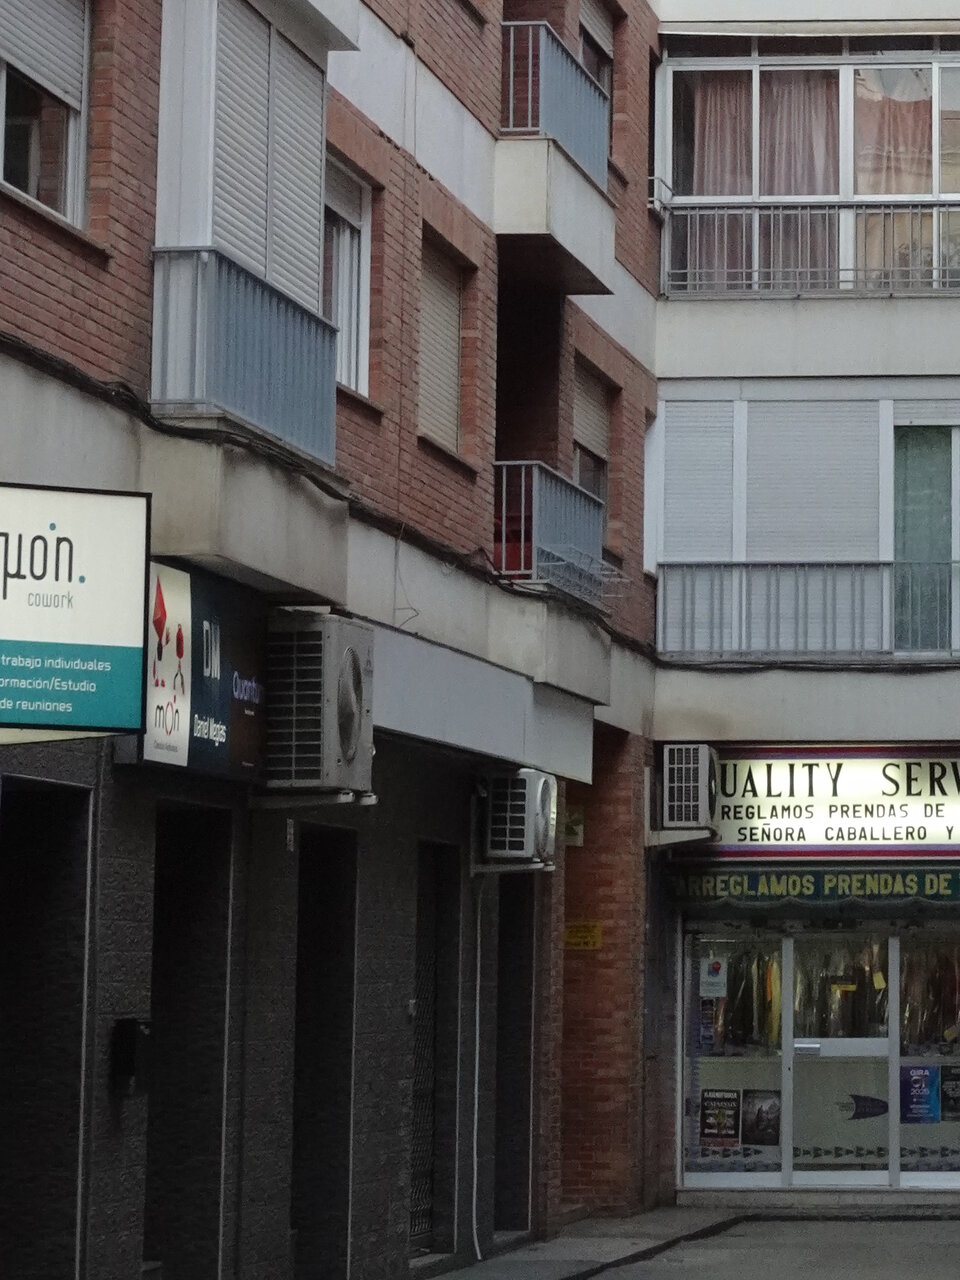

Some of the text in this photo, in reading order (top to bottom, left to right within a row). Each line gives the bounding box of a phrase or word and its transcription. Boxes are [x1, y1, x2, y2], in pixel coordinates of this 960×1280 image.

[27, 590, 74, 609] cowork
[1, 655, 111, 671] trabajo individuales
[0, 677, 97, 692] ormación/Estudio
[0, 699, 73, 712] de reuniones
[718, 761, 844, 799] UALITY
[721, 804, 815, 820] REGLAMOS
[829, 803, 909, 819] PRENDAS
[924, 803, 945, 818] DE
[737, 822, 807, 842] SEÑORA
[825, 826, 928, 842] CABALLERO
[945, 826, 954, 840] Y
[824, 873, 919, 896] PRENDAS
[924, 873, 952, 896] DE
